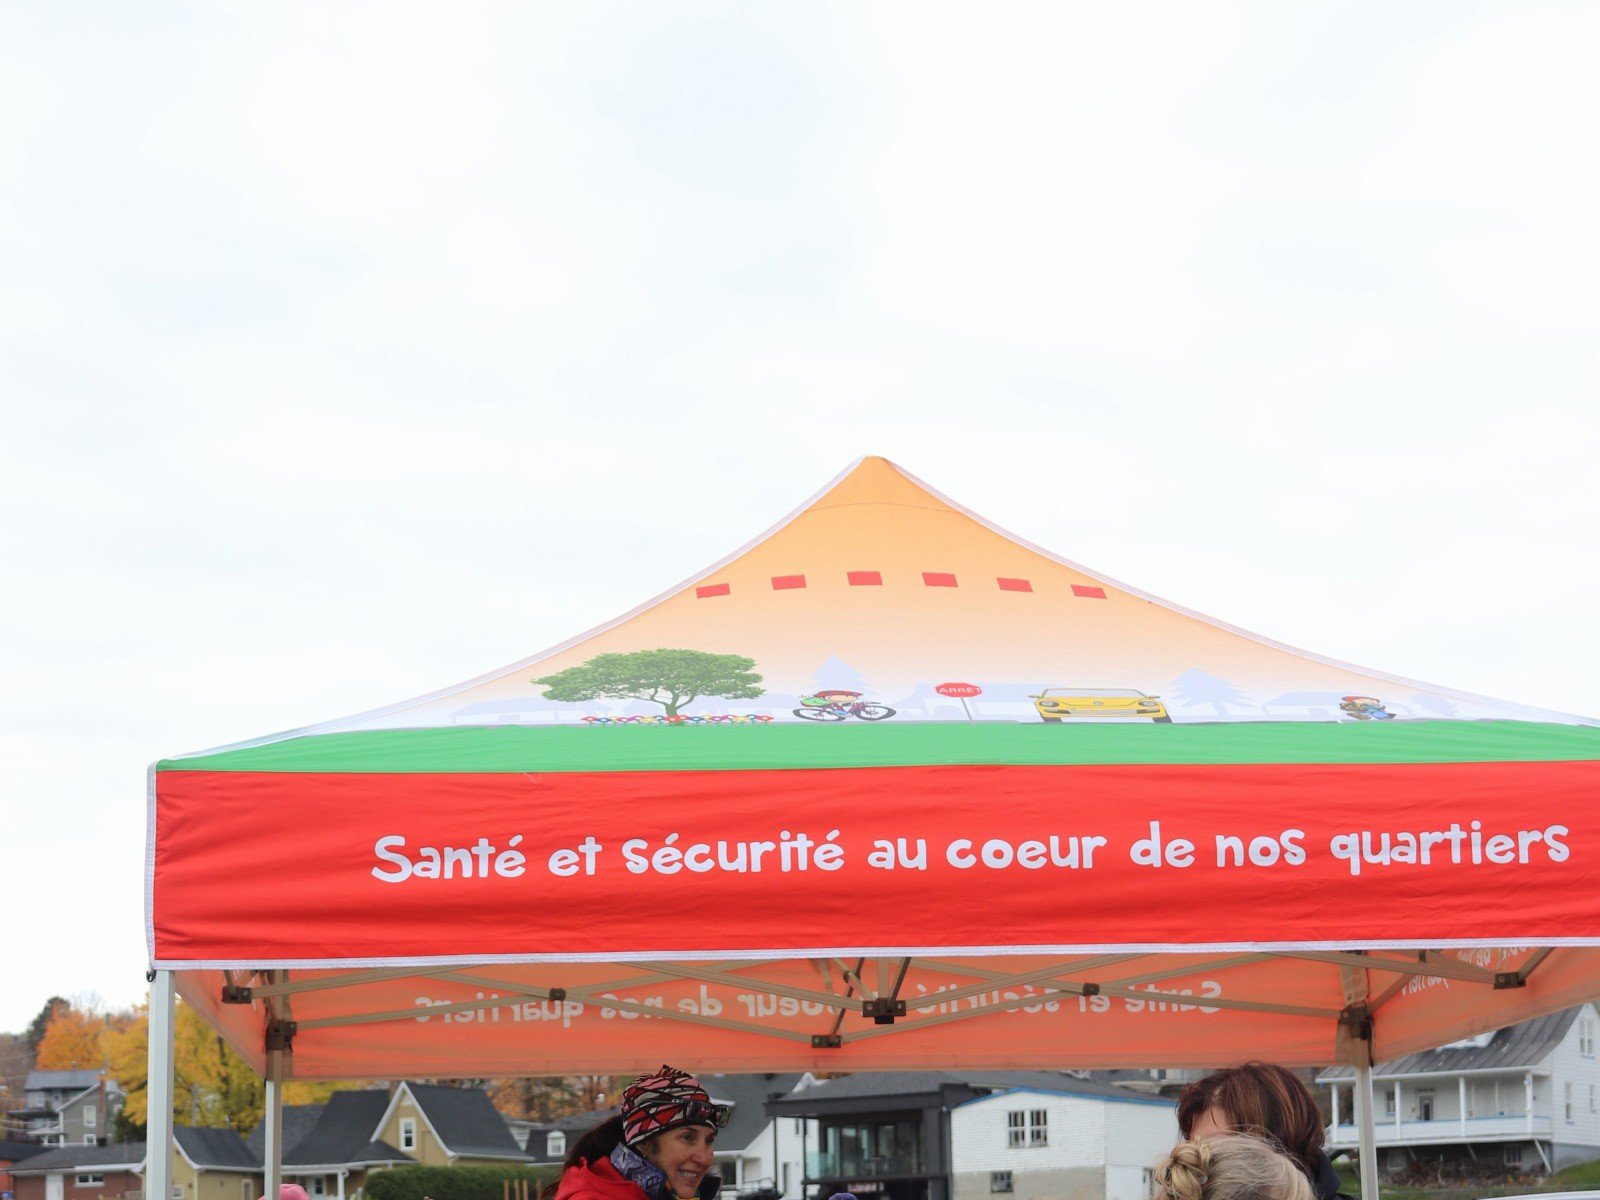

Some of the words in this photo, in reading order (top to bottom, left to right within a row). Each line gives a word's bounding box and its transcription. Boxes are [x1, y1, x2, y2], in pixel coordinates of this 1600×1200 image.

[371, 834, 527, 883] Santé
[547, 836, 603, 876] et
[621, 829, 845, 875] sécurité
[867, 837, 927, 871] au
[945, 835, 1108, 869] coeur
[1129, 820, 1195, 868] de
[1215, 828, 1306, 868] nos
[1330, 820, 1570, 876] quartiers
